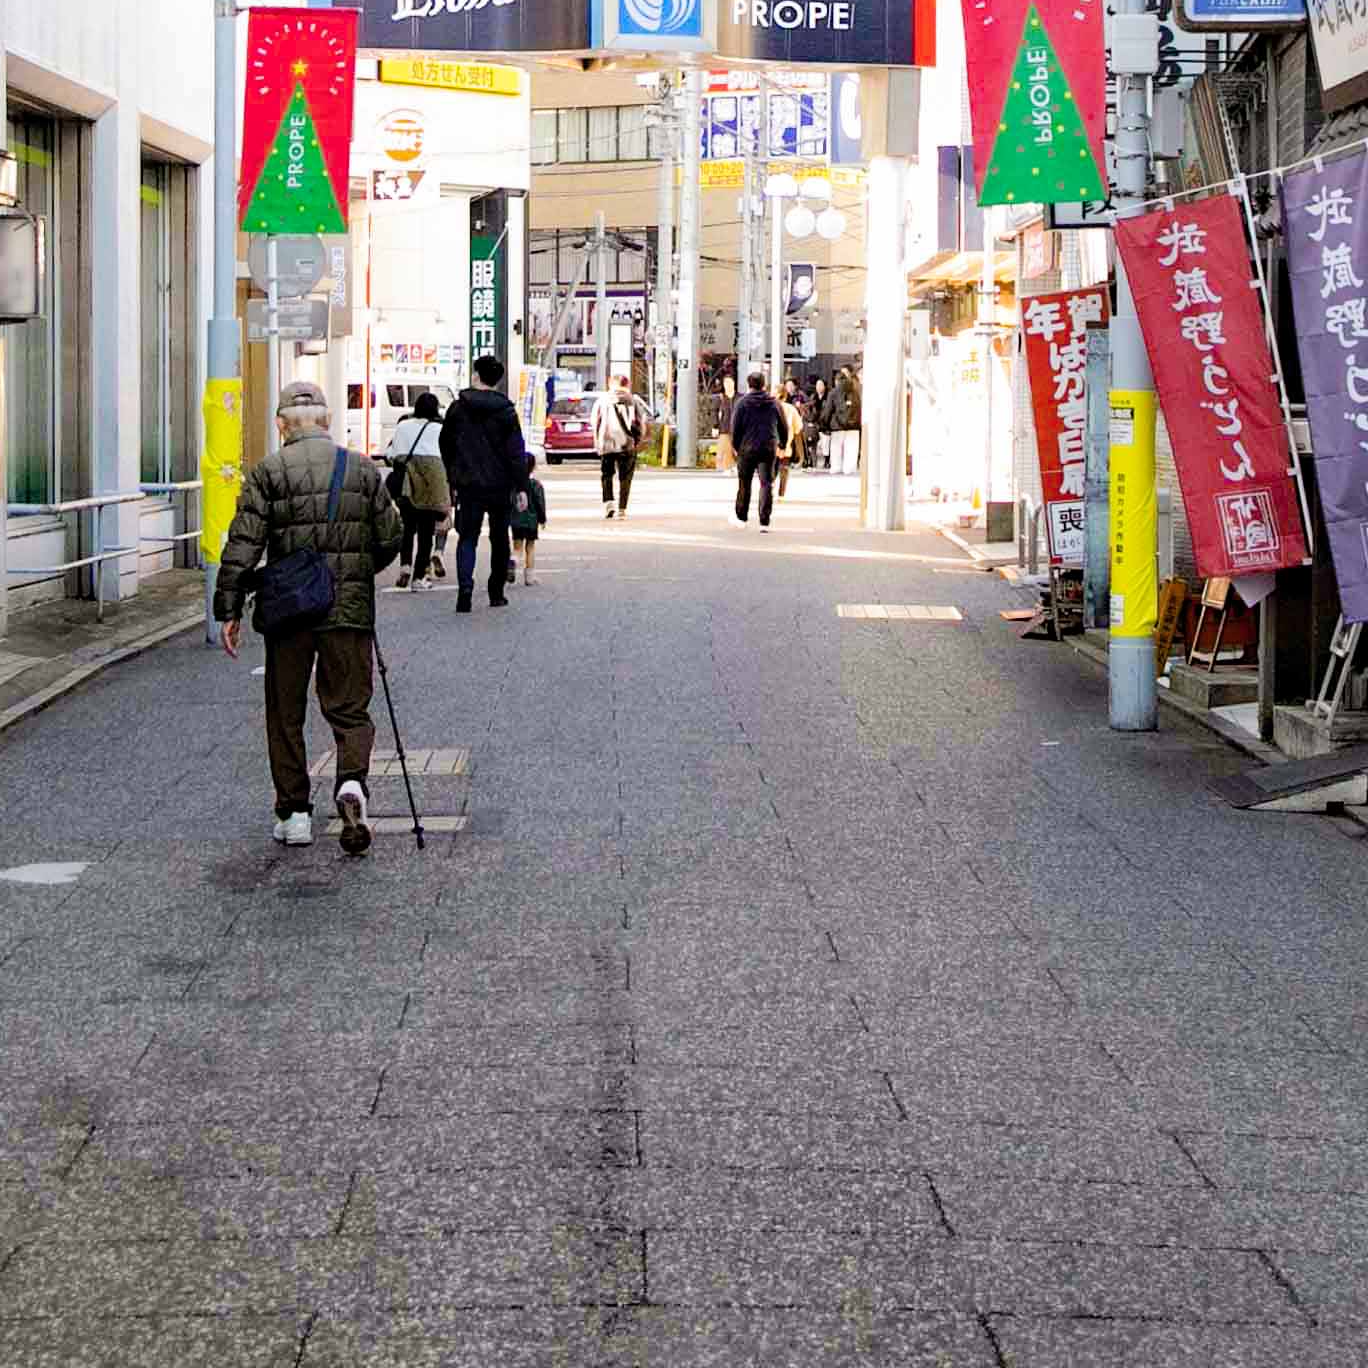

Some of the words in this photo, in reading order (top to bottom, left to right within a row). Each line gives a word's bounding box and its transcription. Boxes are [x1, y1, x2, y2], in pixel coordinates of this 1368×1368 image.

[411, 61, 495, 88] 処方せん受付
[287, 114, 307, 189] PROPE
